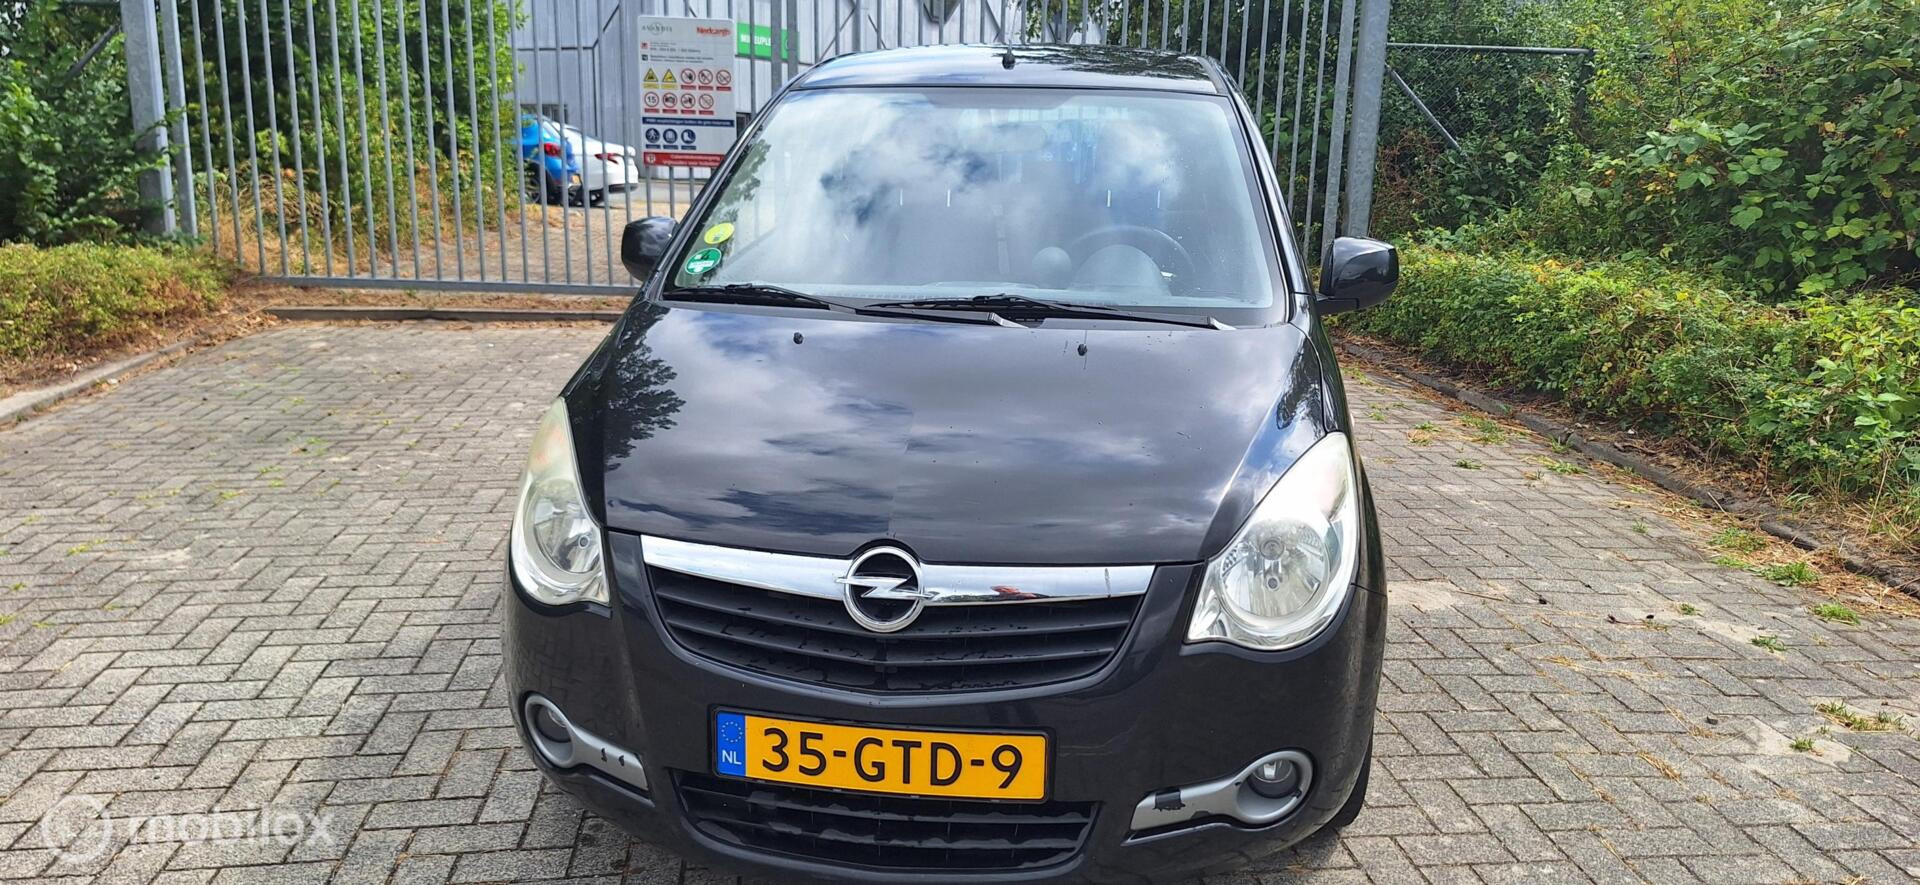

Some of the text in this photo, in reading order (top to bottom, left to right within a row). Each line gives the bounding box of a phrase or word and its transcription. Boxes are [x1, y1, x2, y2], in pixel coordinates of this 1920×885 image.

[647, 95, 657, 103] 15
[721, 750, 742, 765] NL
[762, 728, 1023, 789] 35-GTD-9
